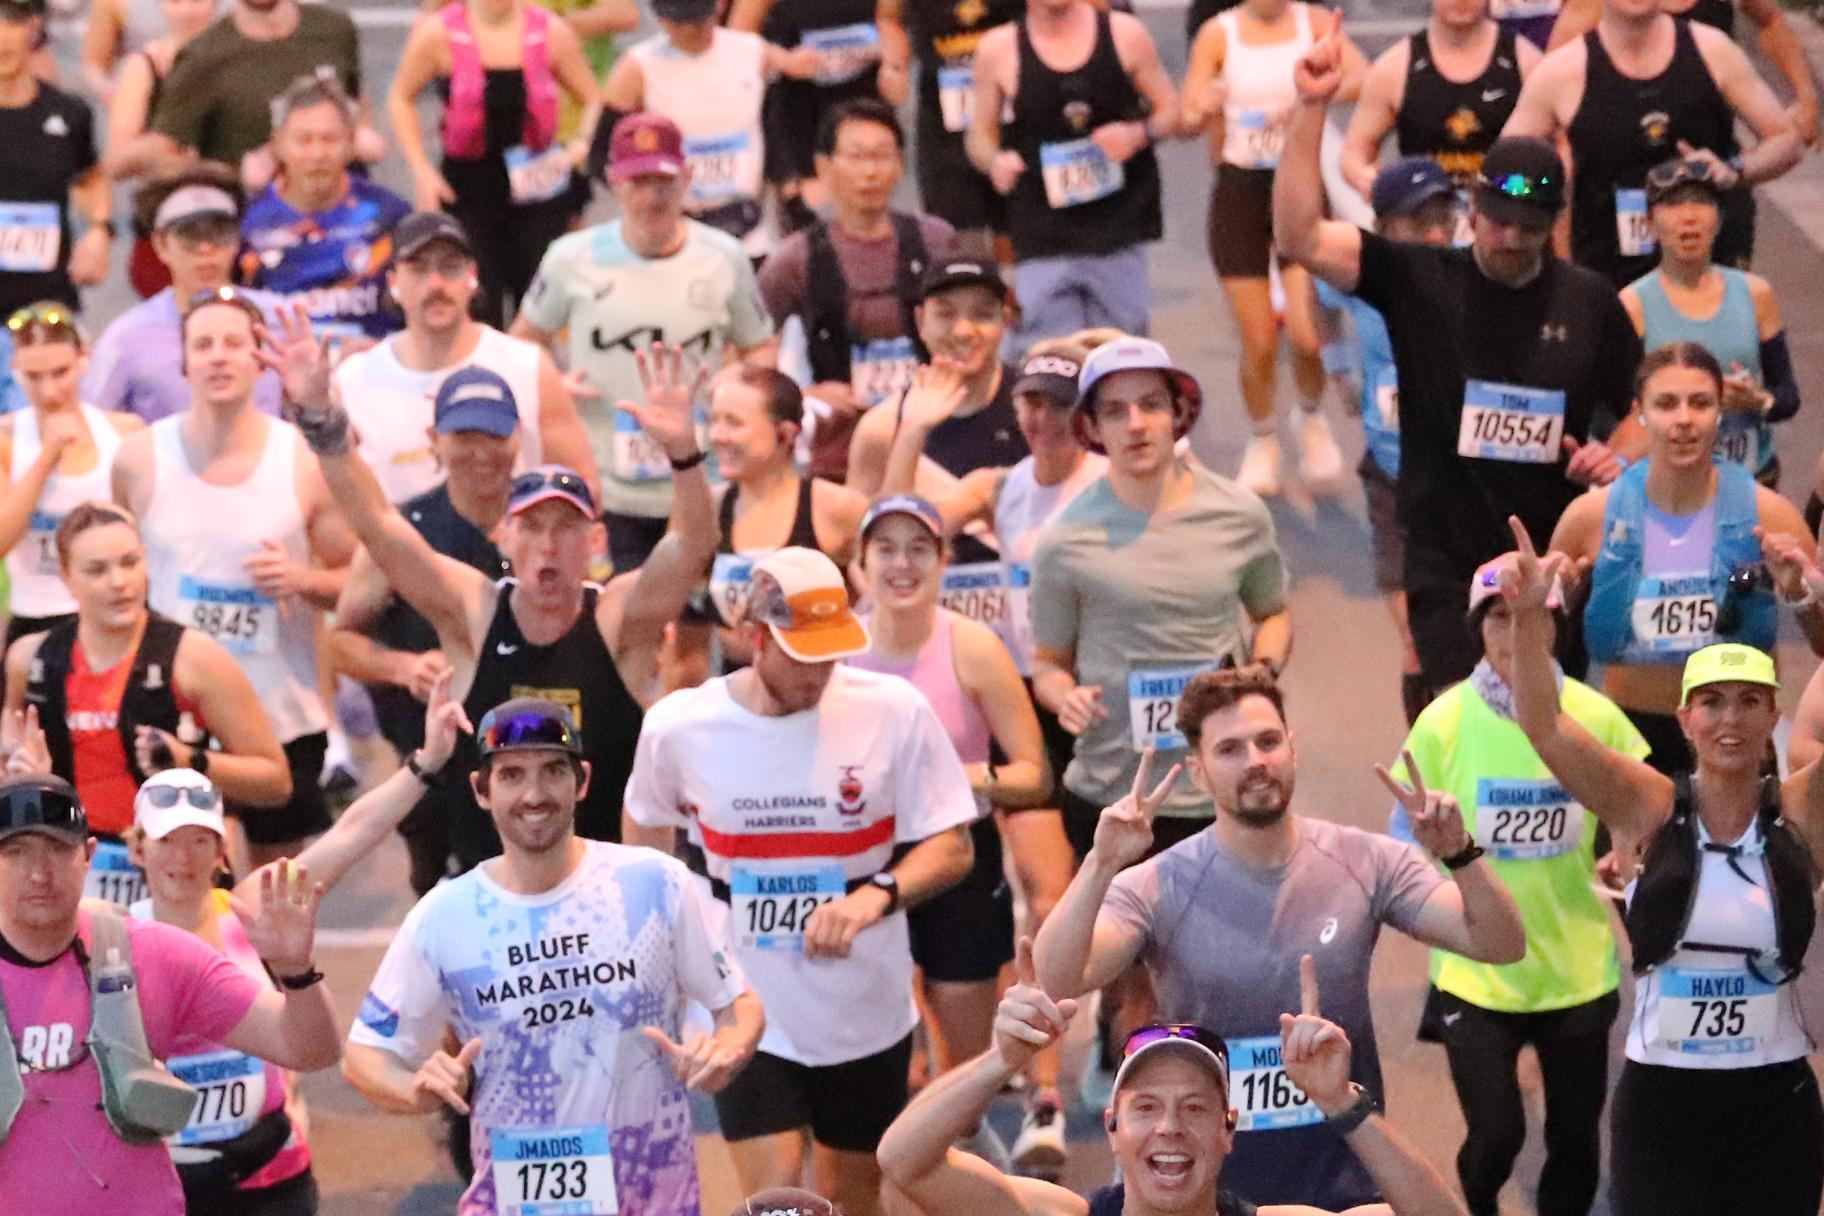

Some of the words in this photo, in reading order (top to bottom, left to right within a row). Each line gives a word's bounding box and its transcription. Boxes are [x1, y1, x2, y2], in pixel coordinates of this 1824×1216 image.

[1474, 411, 1553, 447] 10554
[192, 604, 259, 639] 9845
[1651, 599, 1714, 635] 1615
[732, 796, 827, 811] COLLEGIANS
[744, 816, 816, 828] HARRIERS
[1492, 807, 1567, 843] 2220
[758, 875, 818, 894] KARLOS
[747, 896, 833, 933] 1042
[507, 933, 590, 967] BLUFF
[475, 958, 637, 1007] MARATHON
[1692, 976, 1745, 997] HAYLO
[523, 997, 595, 1028] 2024
[1690, 999, 1748, 1037] 735
[517, 1160, 587, 1200] 1733
